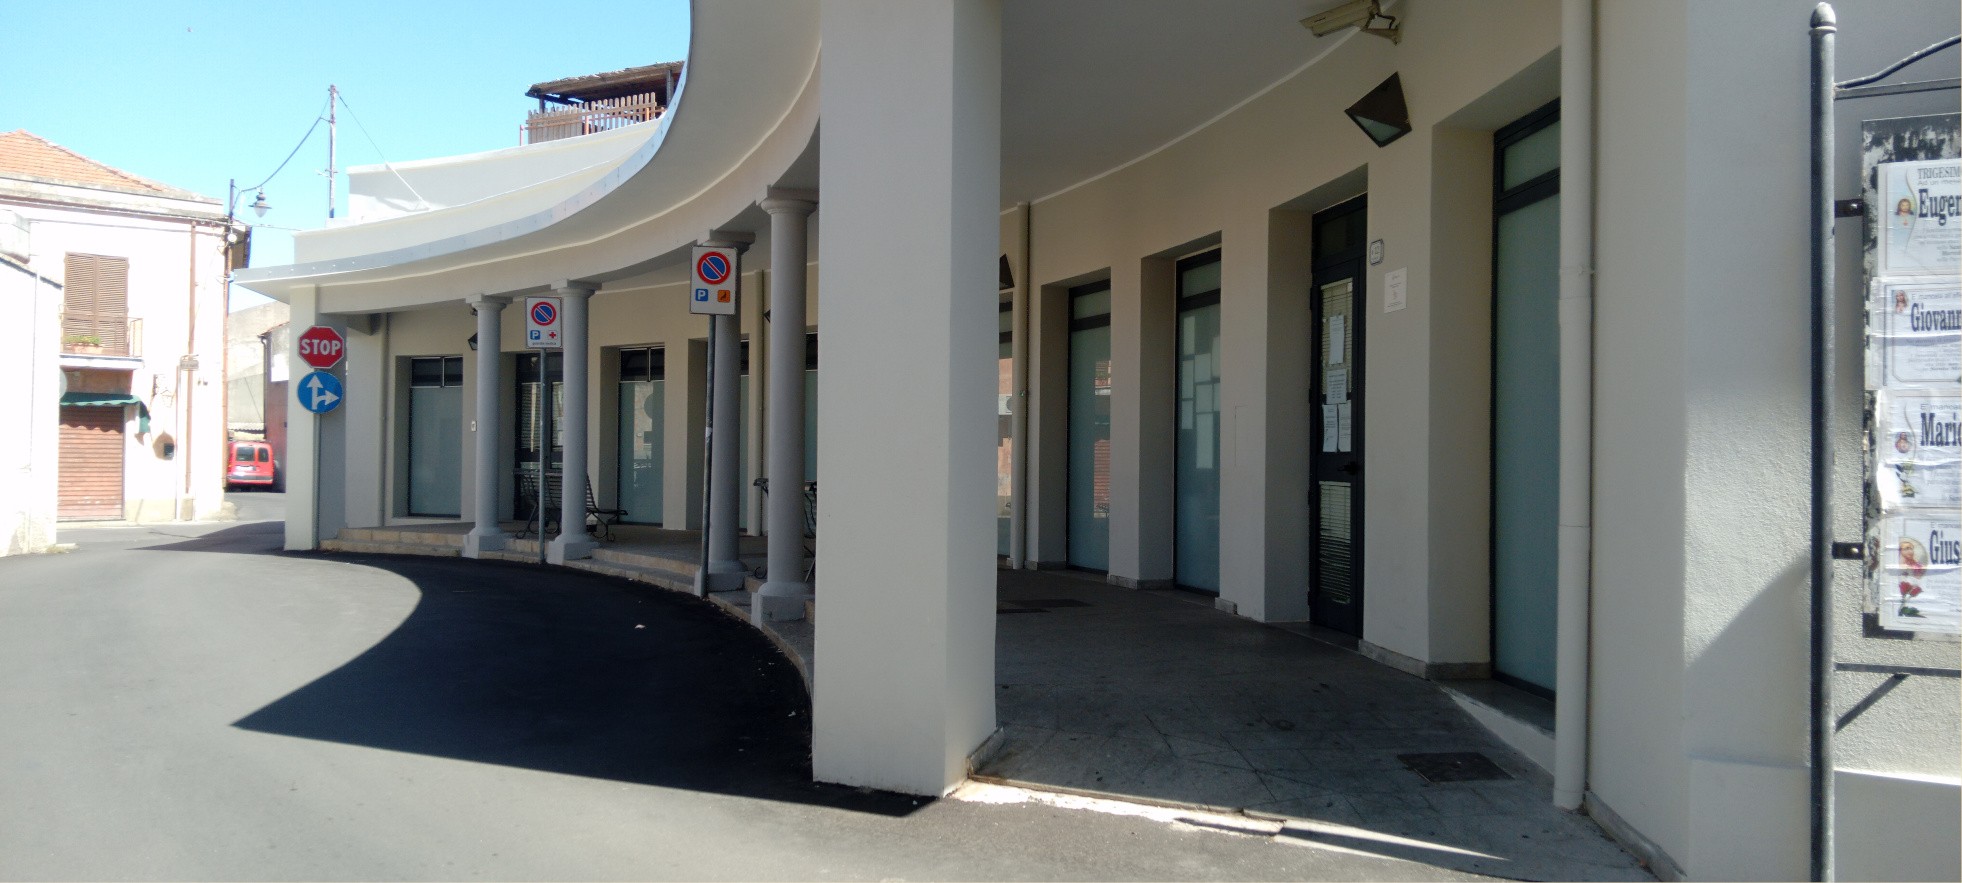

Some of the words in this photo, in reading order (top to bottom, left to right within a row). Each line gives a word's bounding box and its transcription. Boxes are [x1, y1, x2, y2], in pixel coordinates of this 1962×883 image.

[697, 289, 706, 301] P
[532, 330, 540, 340] P
[301, 338, 342, 356] STOP
[1929, 529, 1961, 565] Gius
